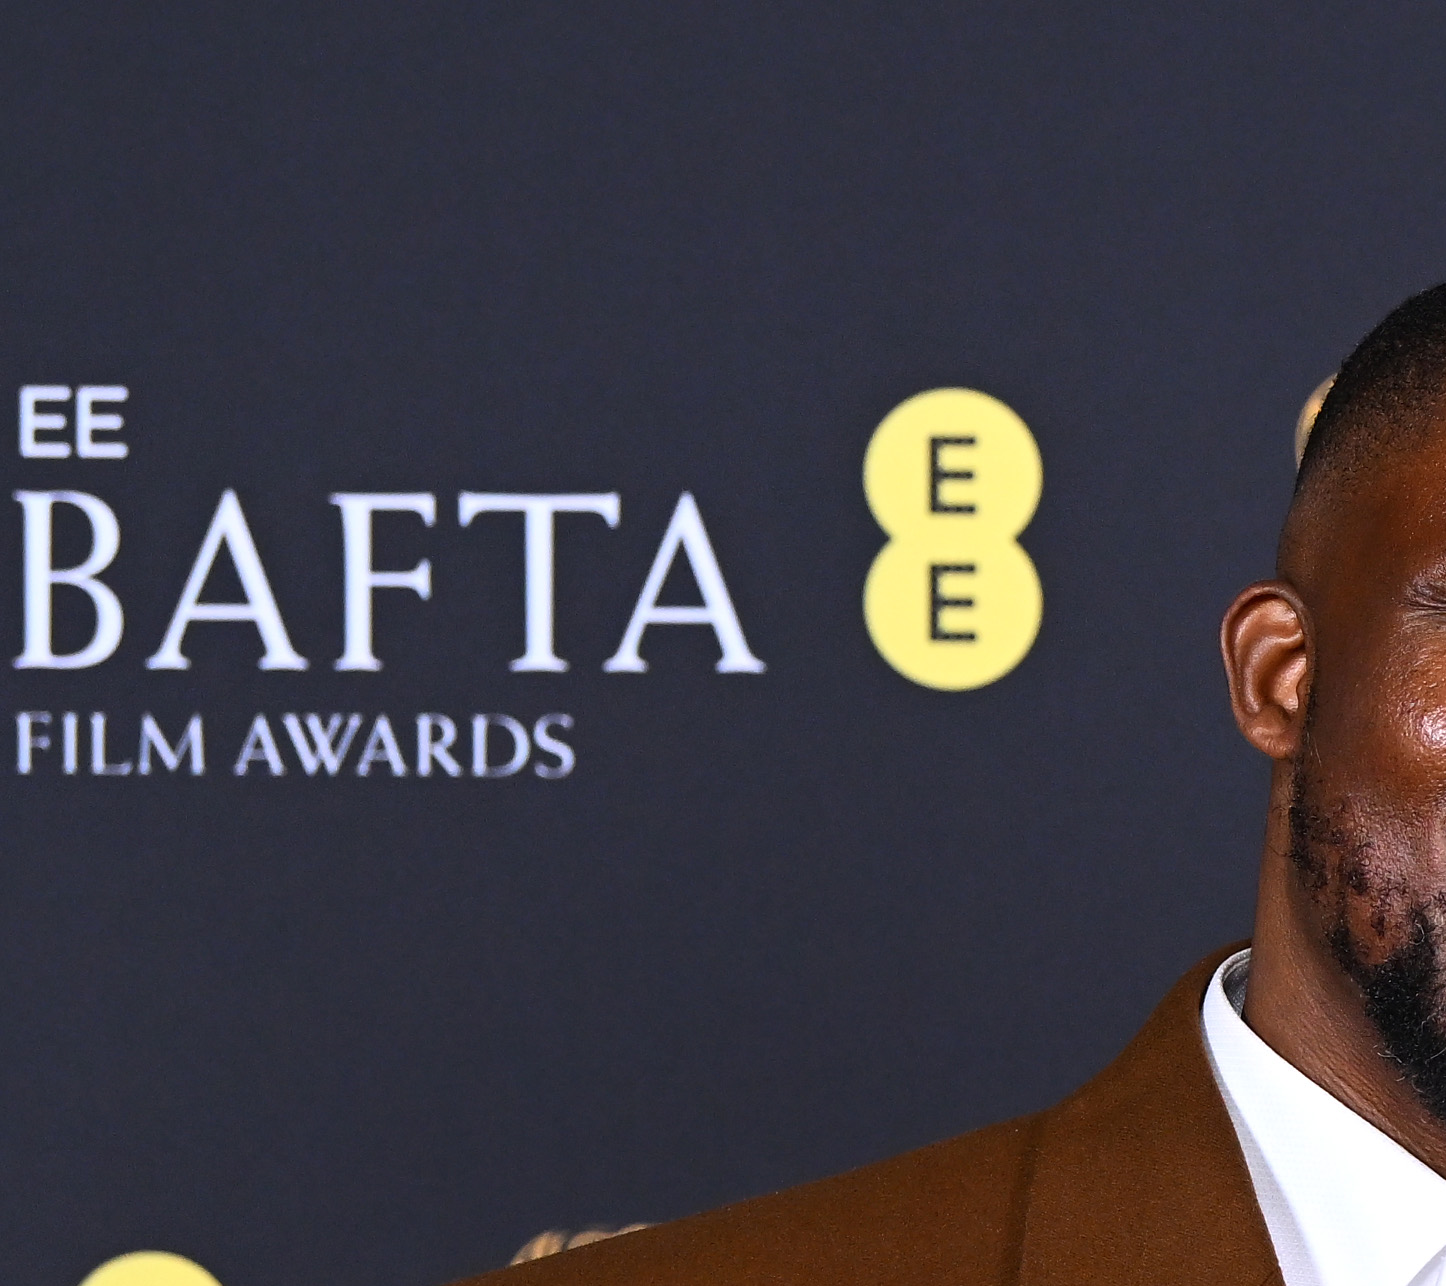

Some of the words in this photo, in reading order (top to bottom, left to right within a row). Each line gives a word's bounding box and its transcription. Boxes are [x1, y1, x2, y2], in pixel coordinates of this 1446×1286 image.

[18, 384, 129, 459] EE
[13, 488, 766, 675] BAFTA
[16, 711, 205, 776] FILM
[234, 712, 576, 778] AWARDS
